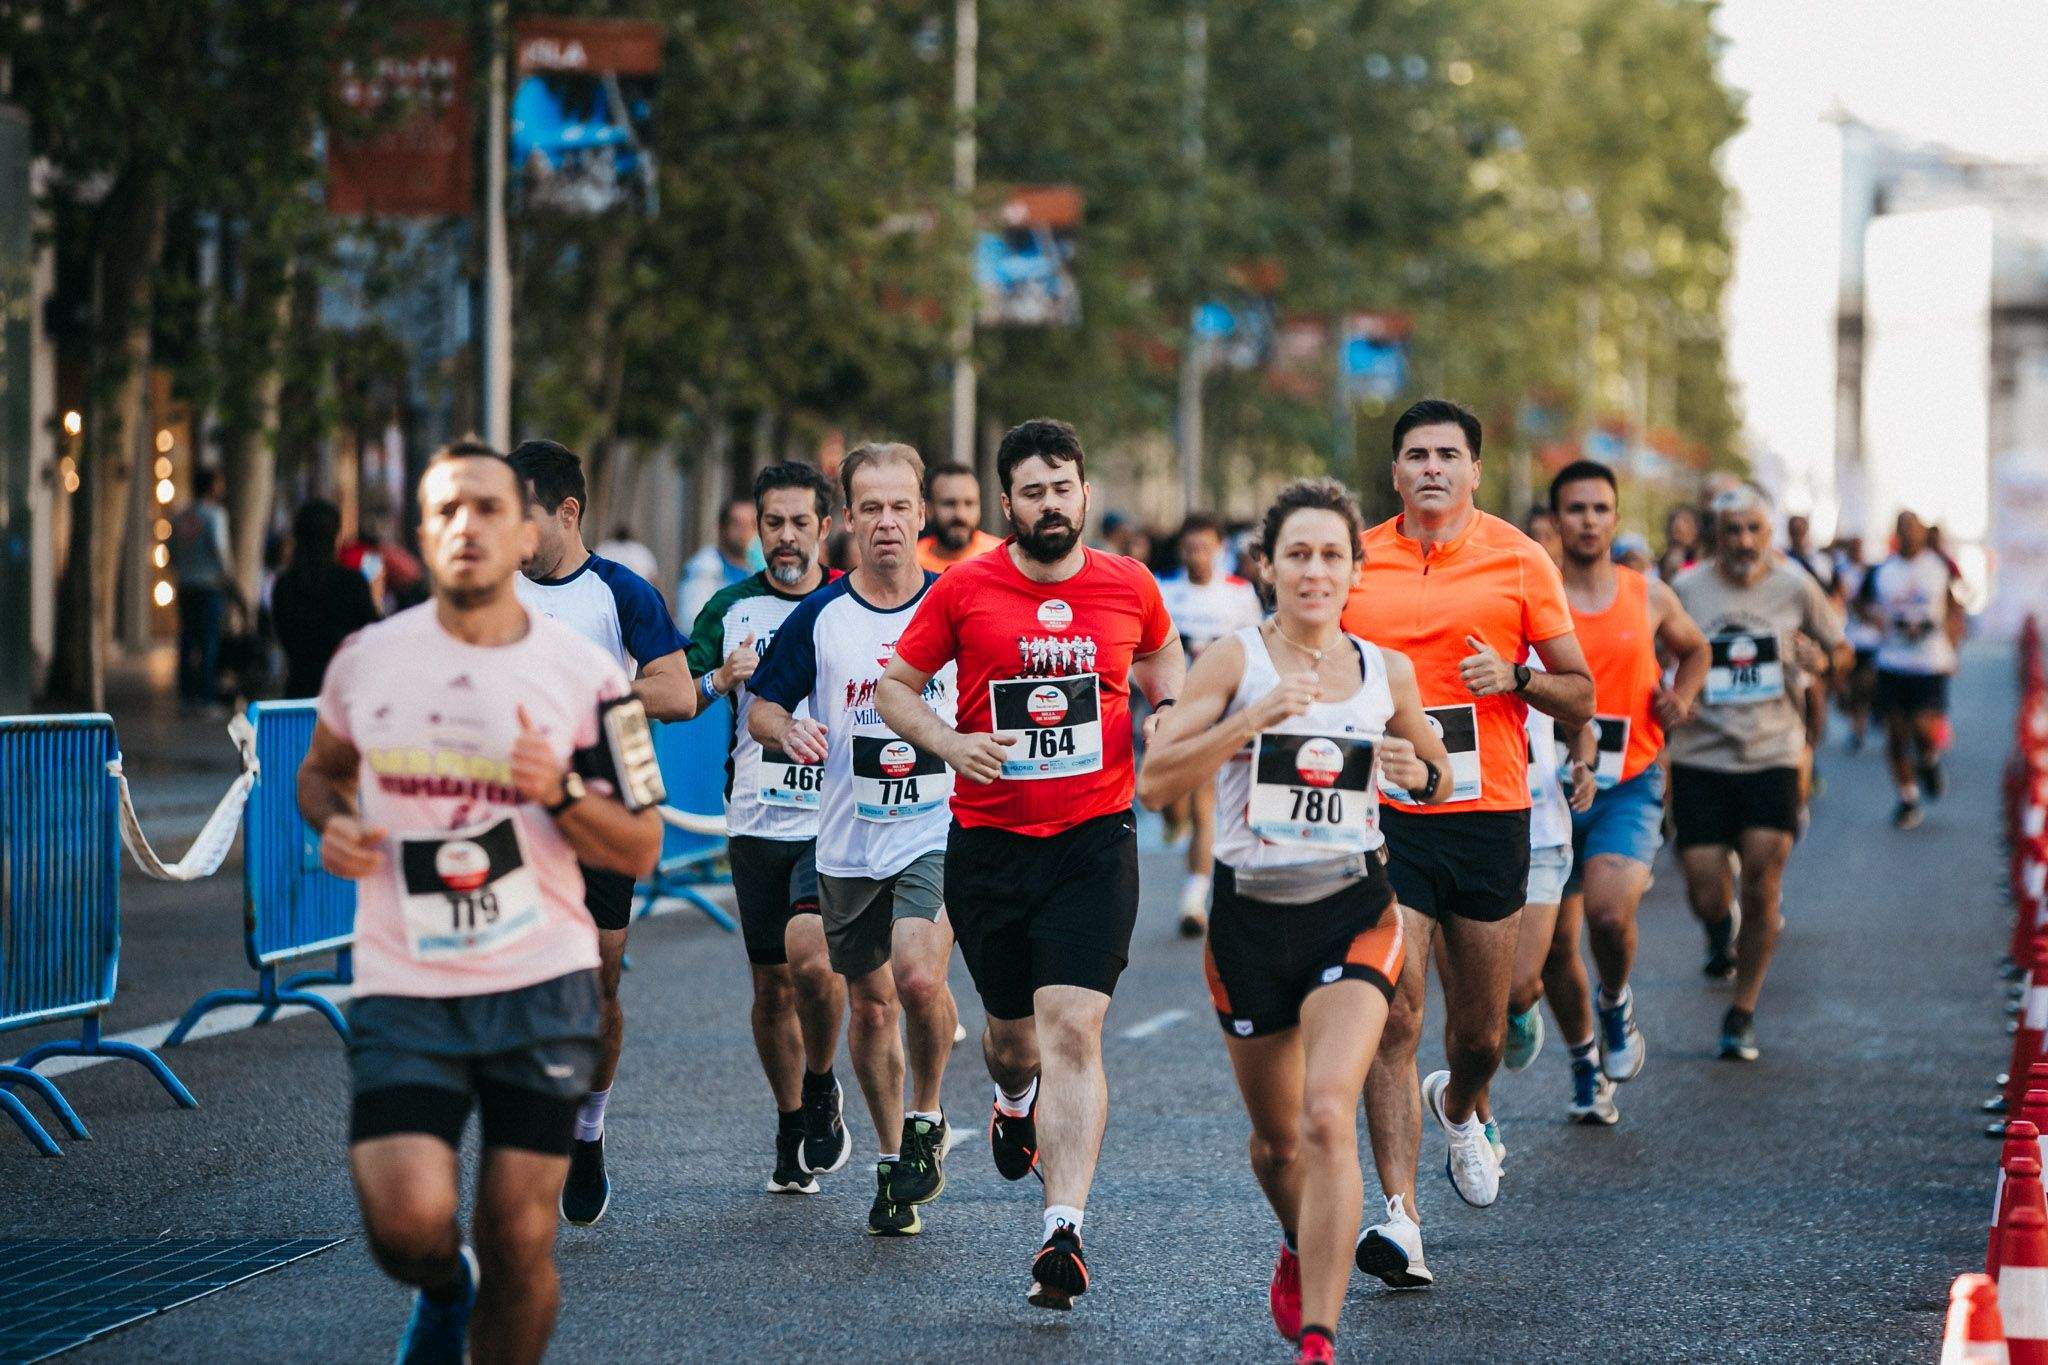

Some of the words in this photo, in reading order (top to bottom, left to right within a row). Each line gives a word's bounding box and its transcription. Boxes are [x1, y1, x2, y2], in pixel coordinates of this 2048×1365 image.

[1025, 728, 1075, 758] 764
[783, 765, 825, 792] 468
[879, 778, 920, 805] 774
[1290, 789, 1342, 824] 780
